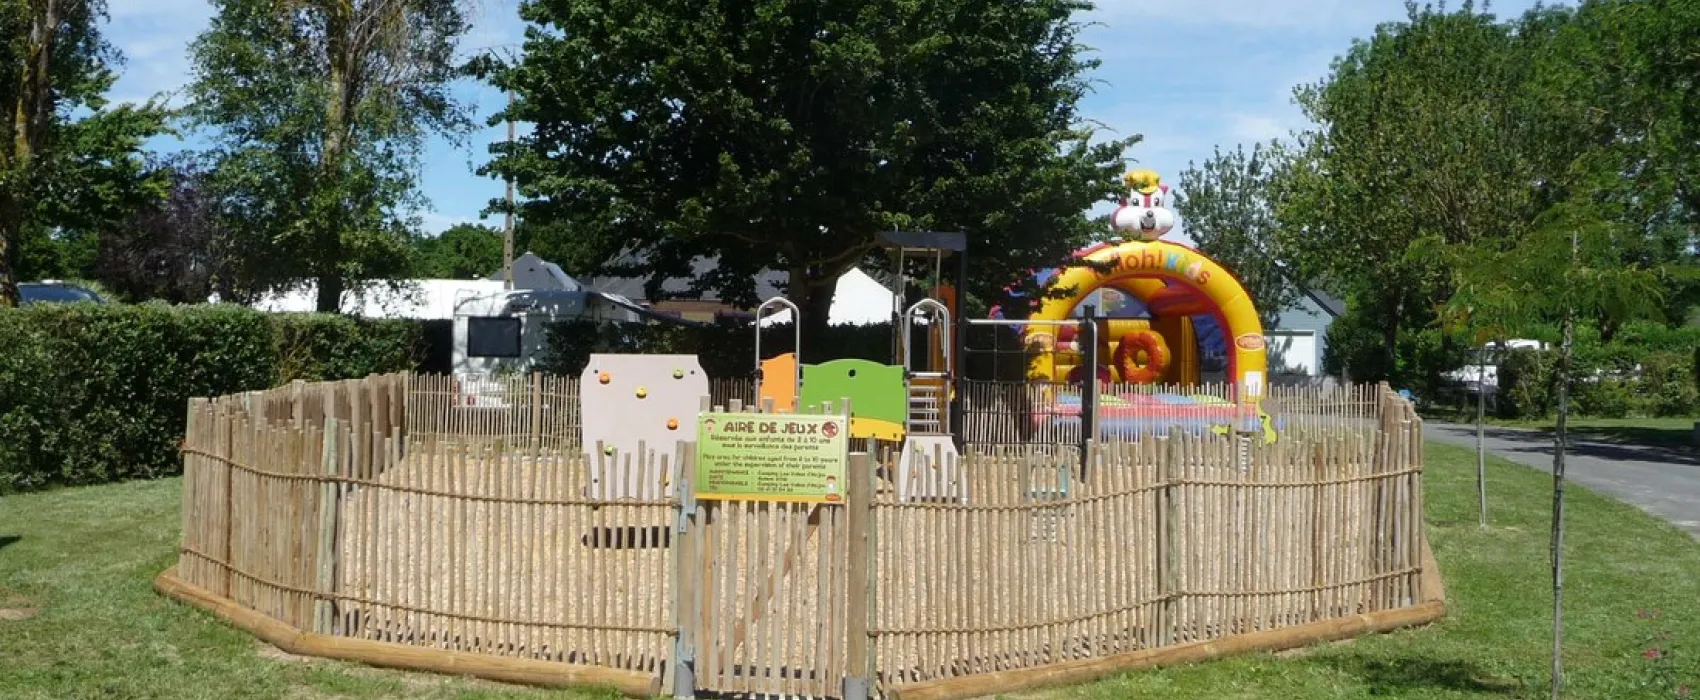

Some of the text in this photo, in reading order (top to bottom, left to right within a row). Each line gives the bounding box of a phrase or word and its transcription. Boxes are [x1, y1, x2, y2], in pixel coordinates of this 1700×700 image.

[723, 421, 818, 434] AIRE DE JEUX
[758, 434, 784, 443] enfants
